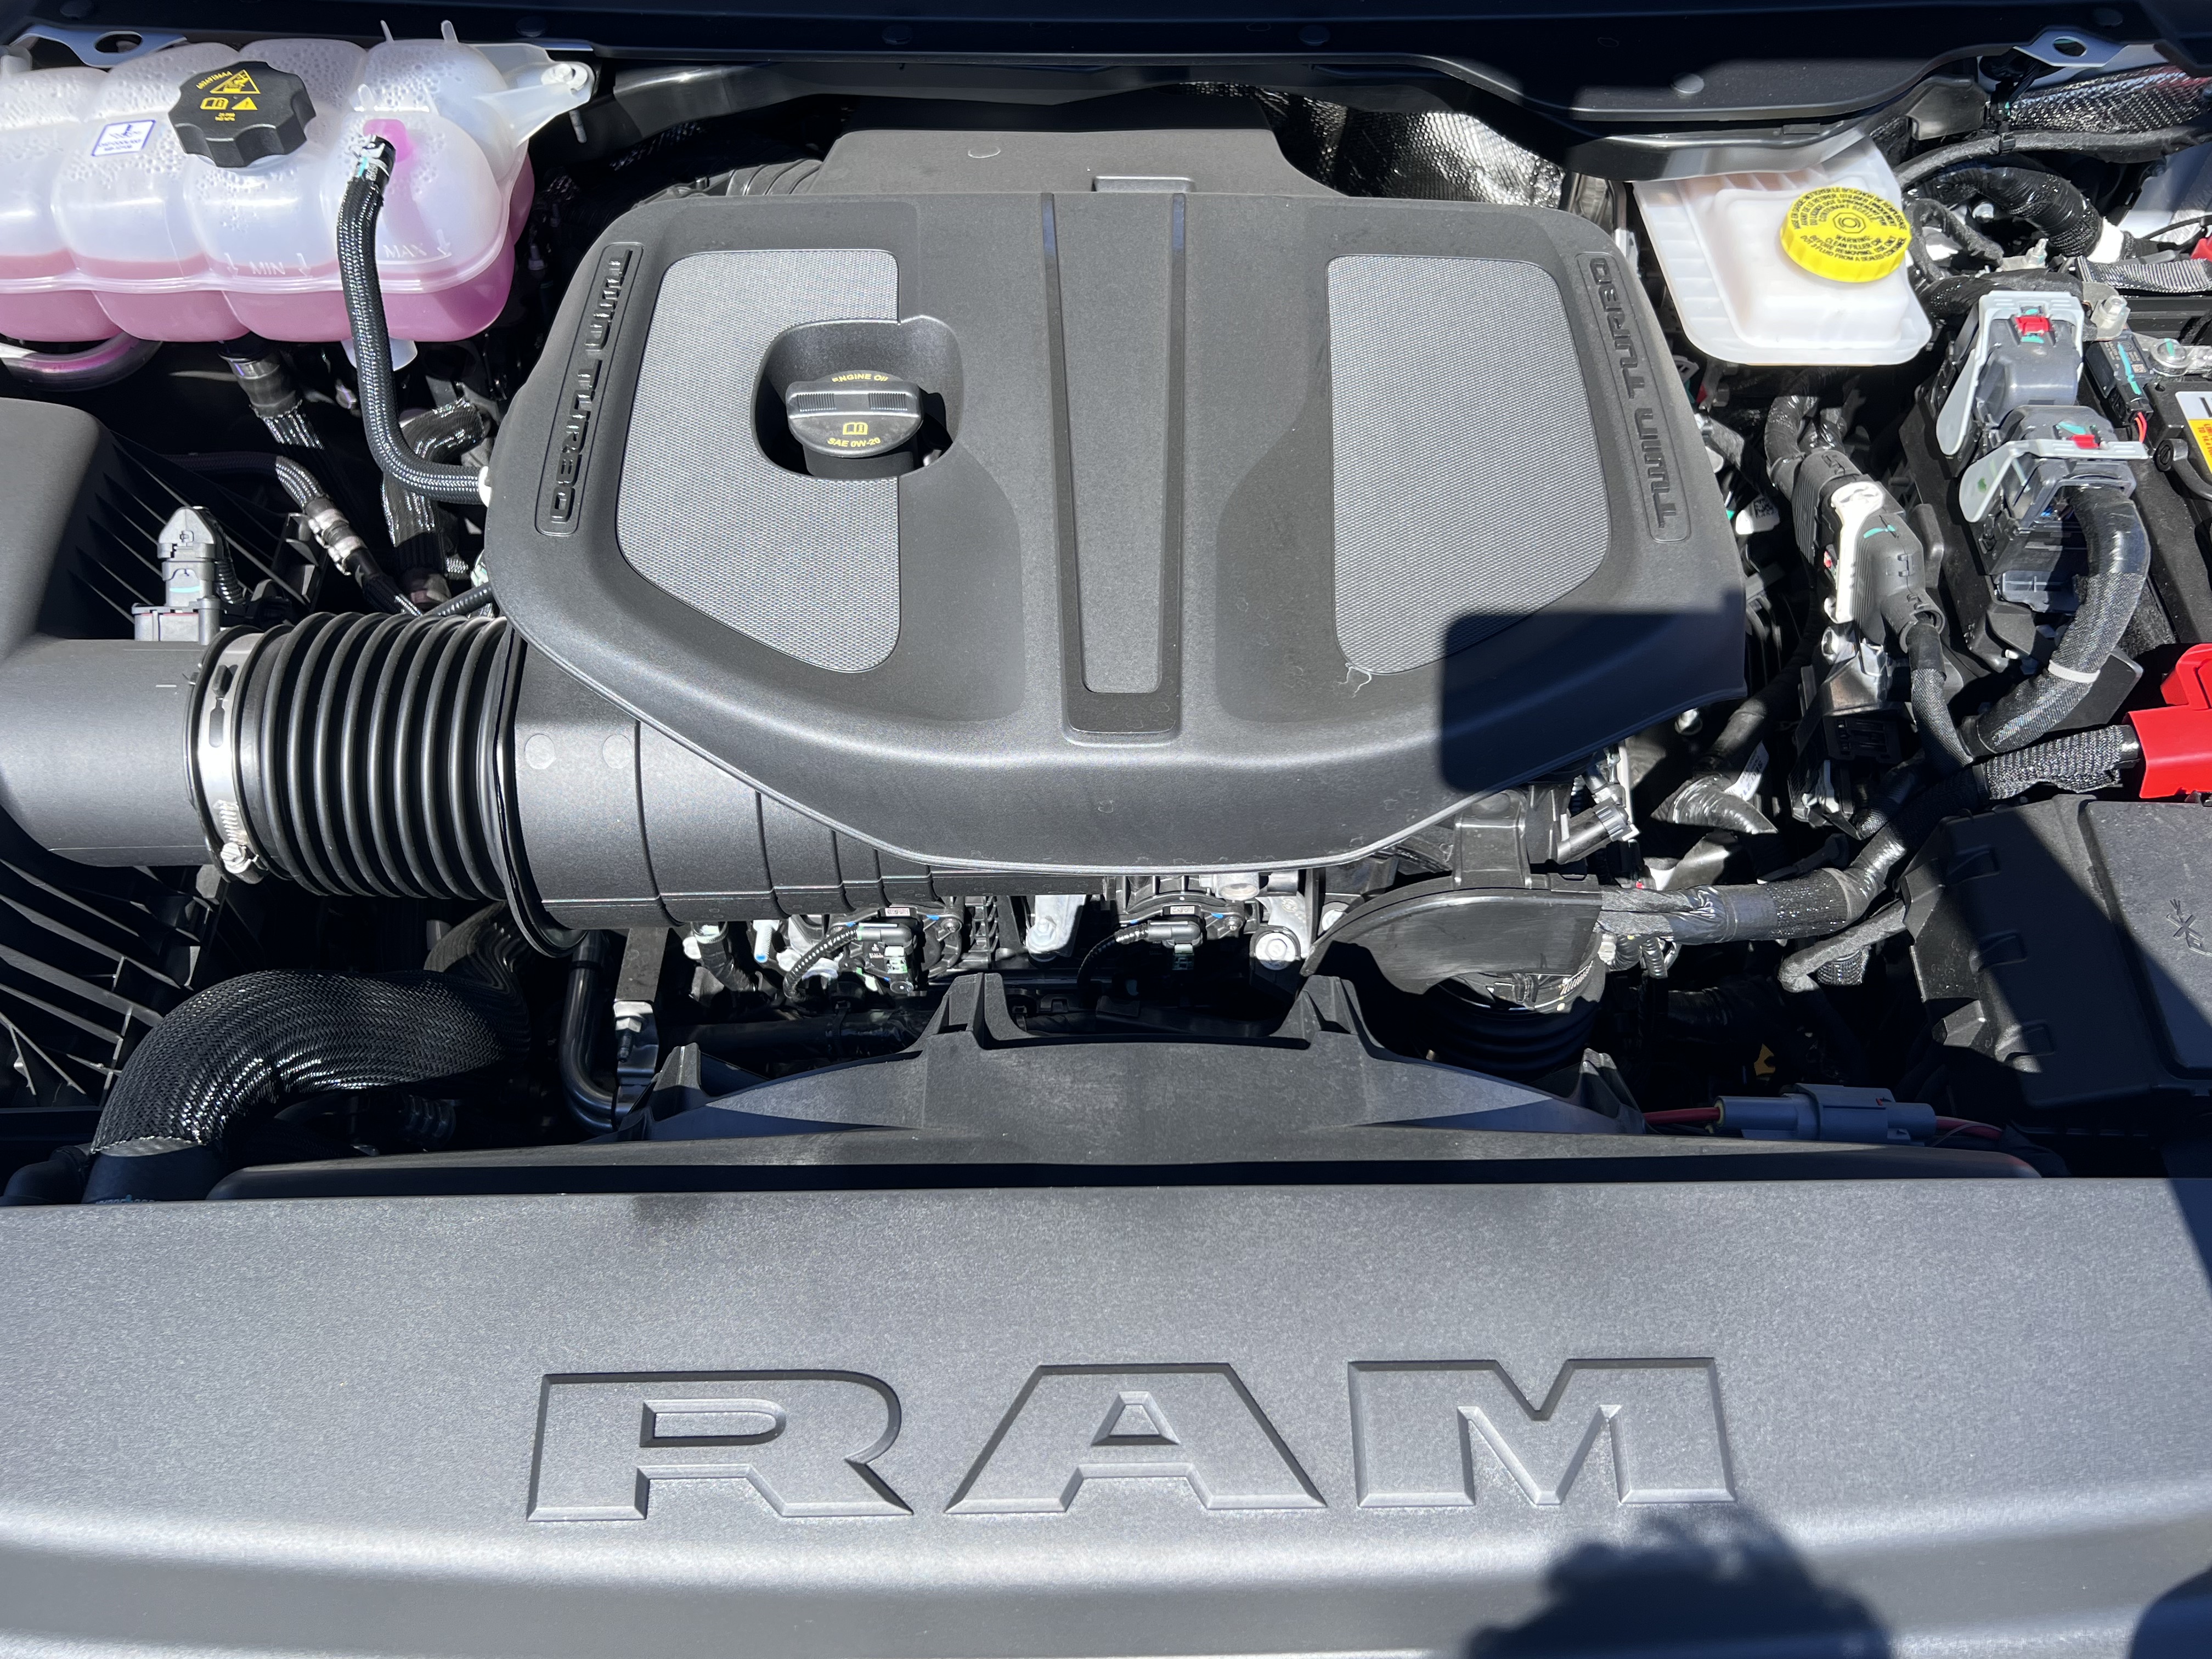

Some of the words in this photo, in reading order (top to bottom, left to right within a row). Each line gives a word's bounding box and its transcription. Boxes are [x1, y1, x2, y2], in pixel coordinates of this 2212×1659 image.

[383, 243, 427, 258] MAX
[1799, 235, 1814, 245] DOT
[1815, 246, 1835, 257] FLUID
[1809, 235, 1835, 251] BEFORE
[1824, 237, 1847, 249] CLEAN
[250, 261, 286, 275] MIN
[584, 250, 633, 352] TWIN
[1590, 257, 1645, 399] TURBO
[832, 374, 872, 382] ENGINE
[550, 360, 602, 523] TURBO
[827, 437, 849, 448] SAE
[850, 437, 881, 448] 0W-20
[1634, 408, 1677, 528] TWIN
[526, 1357, 1735, 1522] RAM
